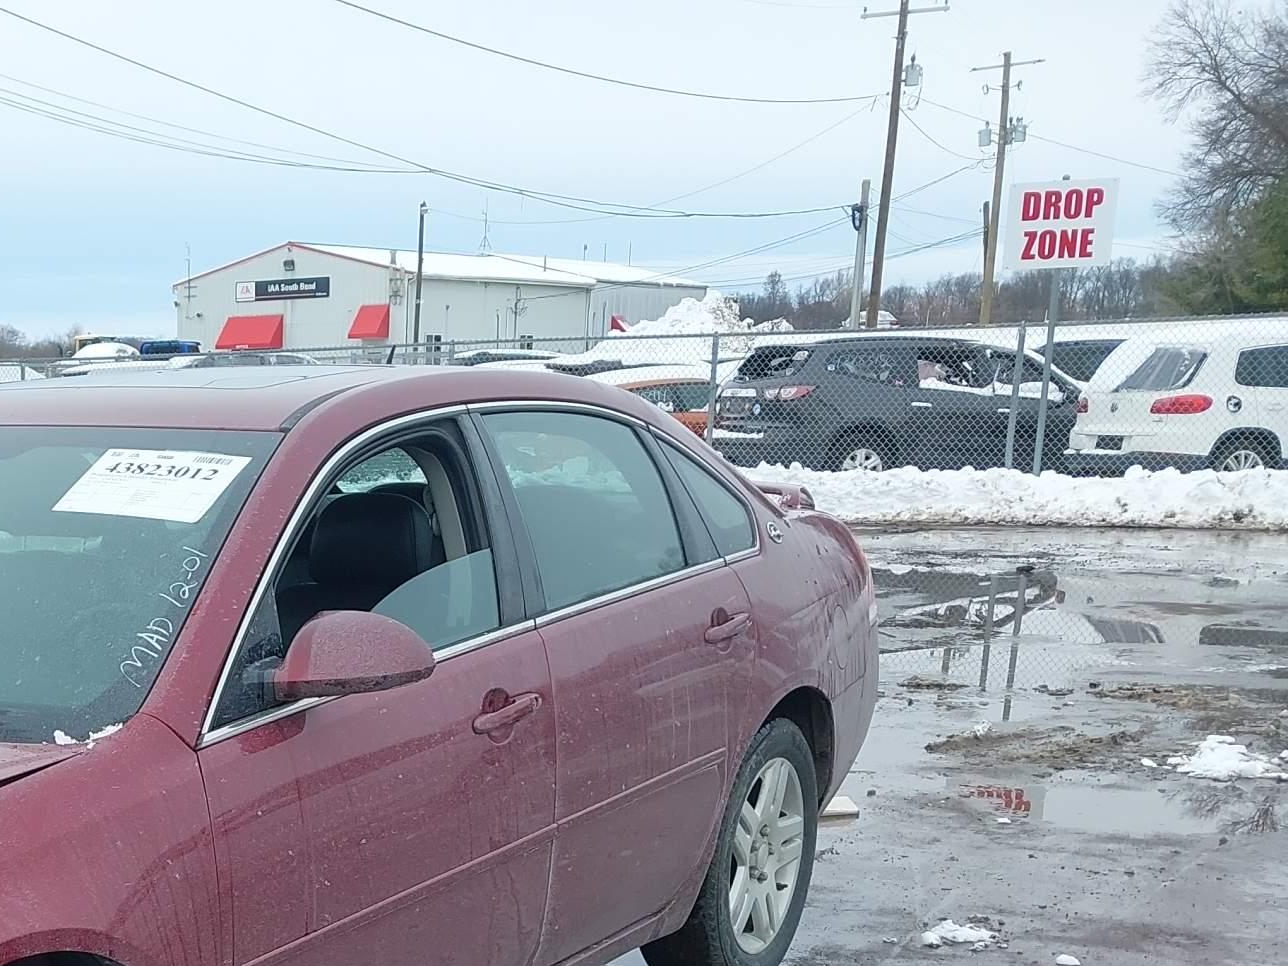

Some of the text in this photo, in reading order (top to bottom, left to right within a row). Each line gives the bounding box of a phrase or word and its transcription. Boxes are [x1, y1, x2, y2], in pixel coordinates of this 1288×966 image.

[1021, 188, 1104, 221] DROP
[1020, 228, 1095, 260] ZONE
[281, 282, 298, 291] South
[300, 281, 316, 290] Bend
[105, 461, 219, 480] 43823012
[120, 546, 208, 688] MAD 12-01
